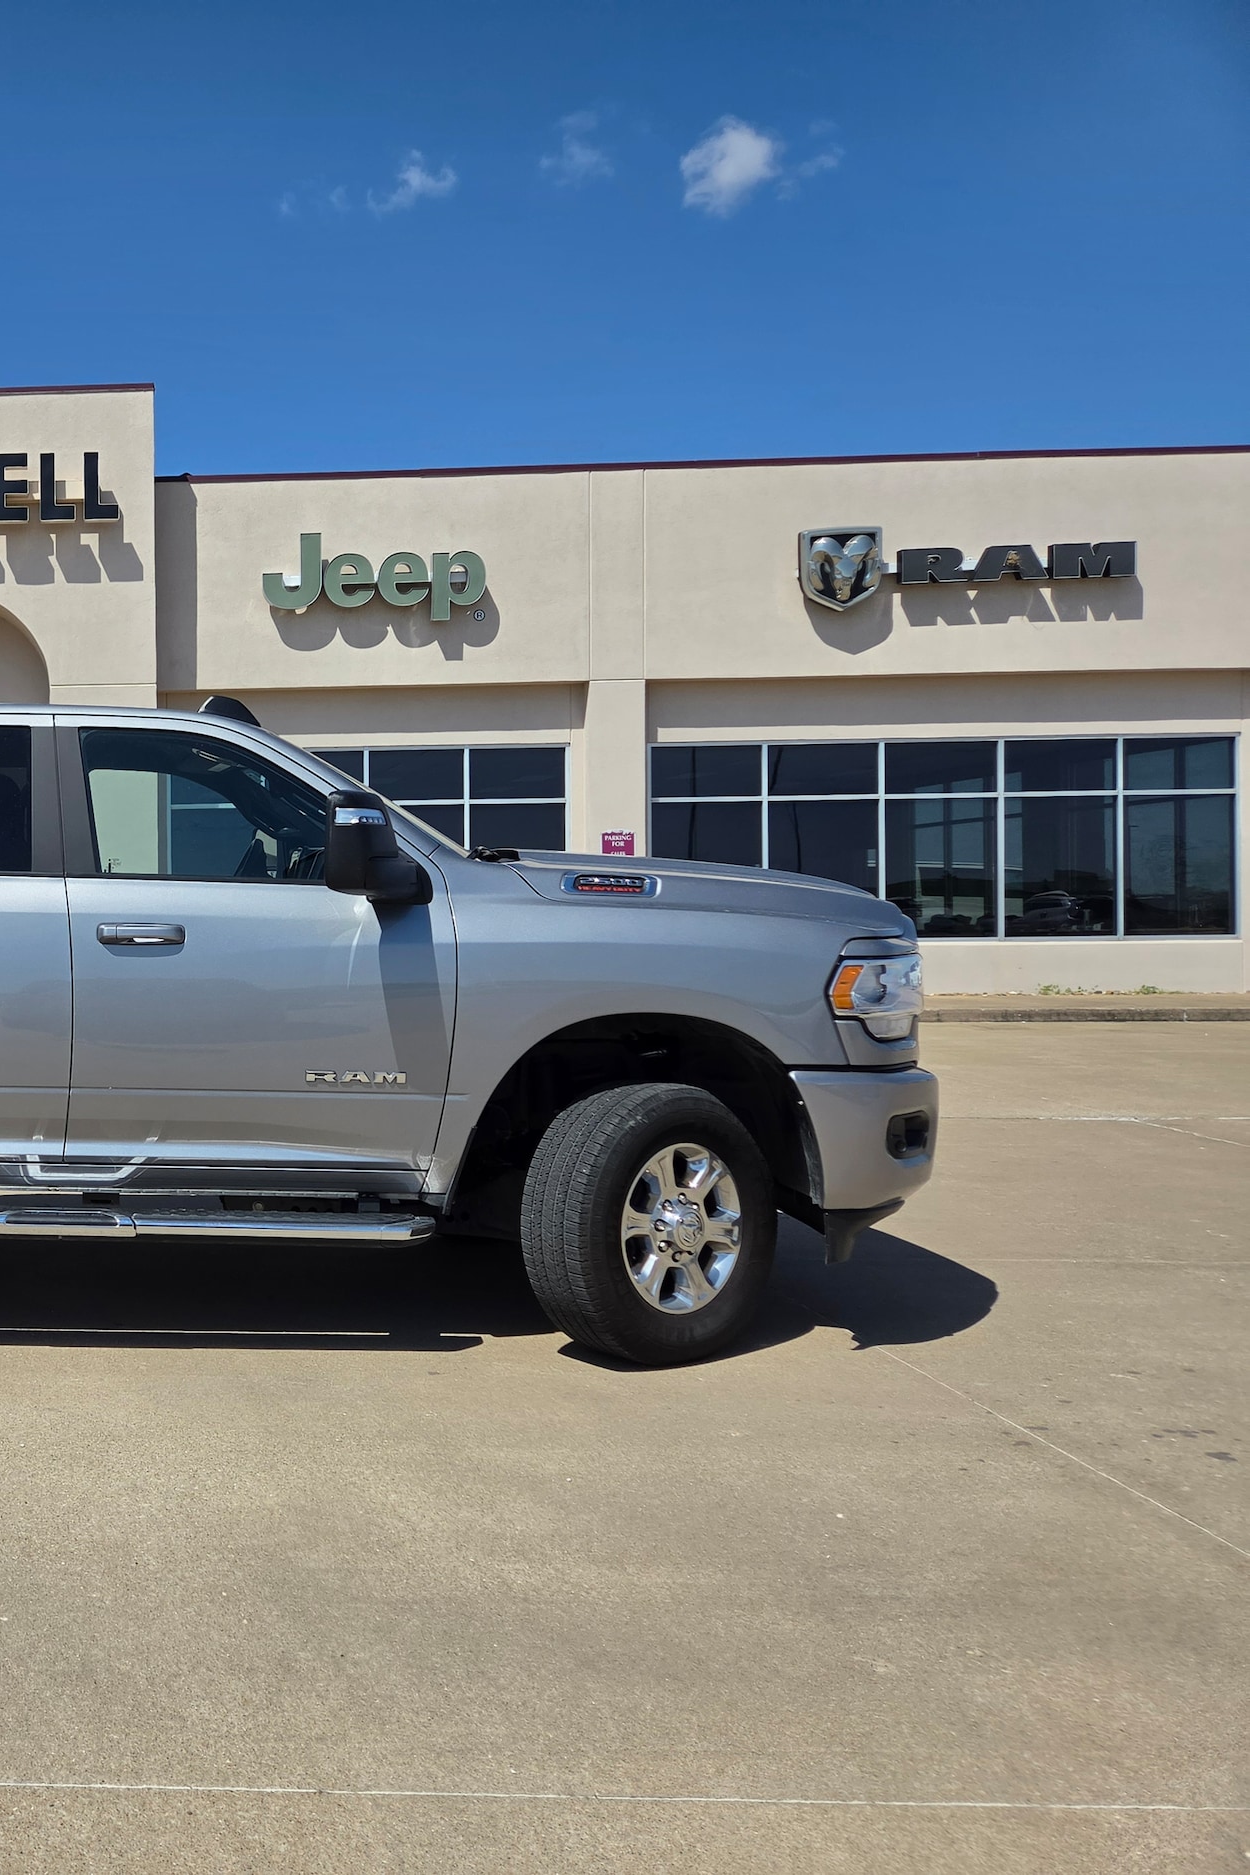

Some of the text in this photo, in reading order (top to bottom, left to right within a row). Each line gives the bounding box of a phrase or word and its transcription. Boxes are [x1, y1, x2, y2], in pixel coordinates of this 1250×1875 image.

[262, 532, 487, 621] Jeep
[897, 541, 1137, 584] RAM
[579, 877, 642, 886] 2500
[305, 1069, 408, 1085] RAM
